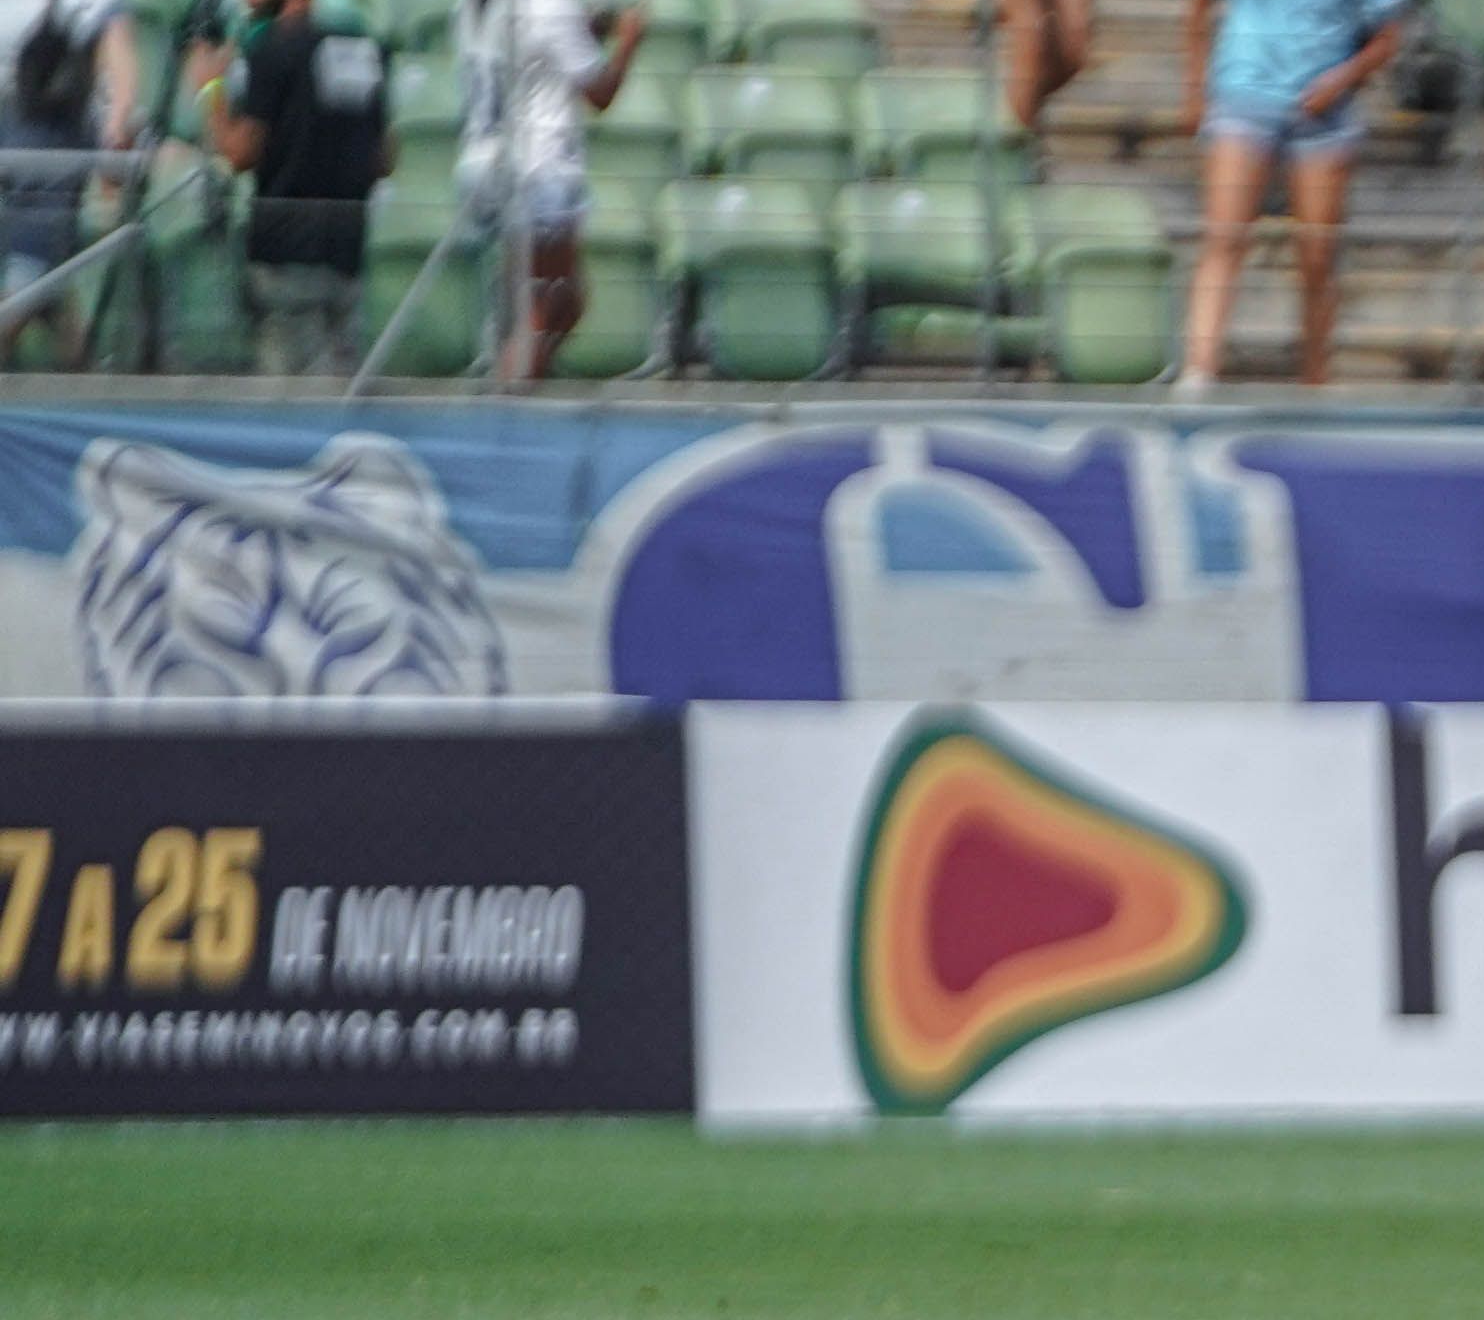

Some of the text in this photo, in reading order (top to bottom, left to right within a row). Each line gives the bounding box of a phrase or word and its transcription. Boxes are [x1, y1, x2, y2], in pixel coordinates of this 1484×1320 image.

[58, 863, 116, 989] A
[127, 827, 264, 993] 25
[269, 884, 336, 993] DE
[335, 884, 587, 991] NOVEMBRO
